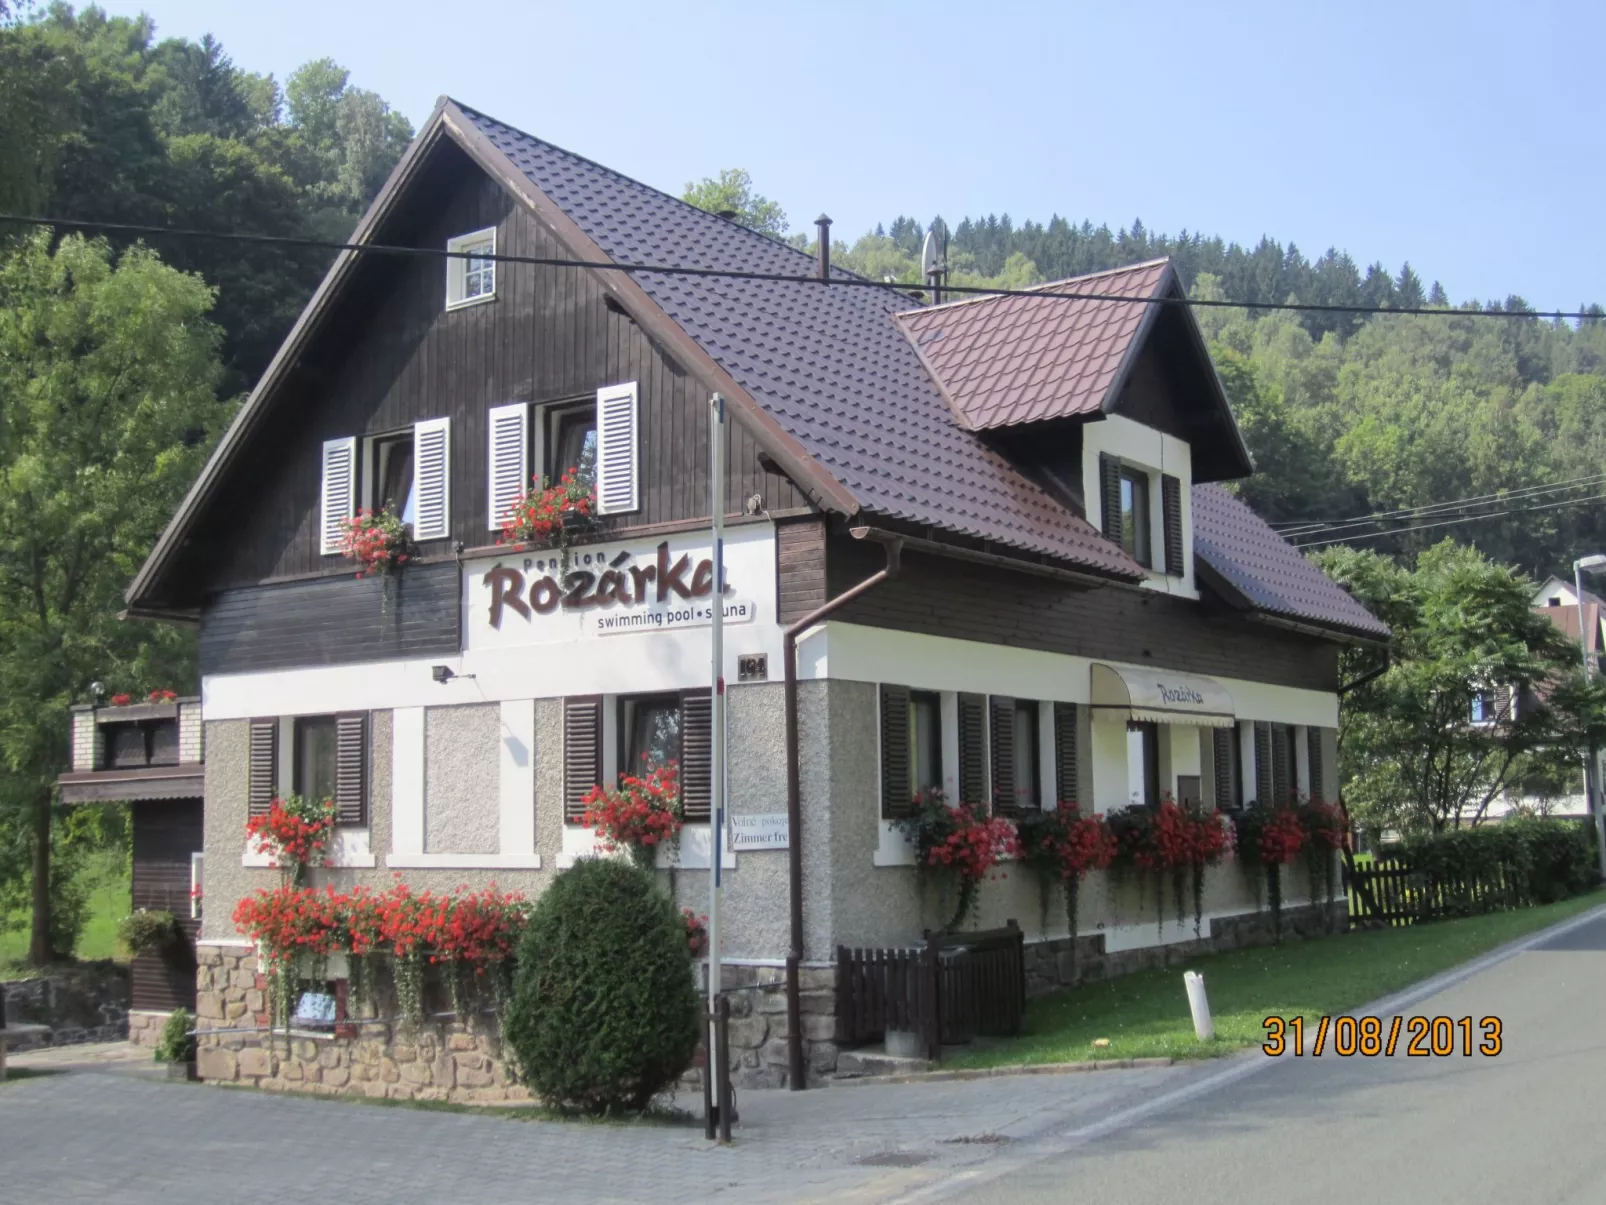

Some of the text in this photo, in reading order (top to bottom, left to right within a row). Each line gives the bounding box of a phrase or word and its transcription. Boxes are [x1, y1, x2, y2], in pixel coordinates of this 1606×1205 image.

[598, 605, 746, 629] swimming pool suna
[734, 833, 772, 844] Zimmer
